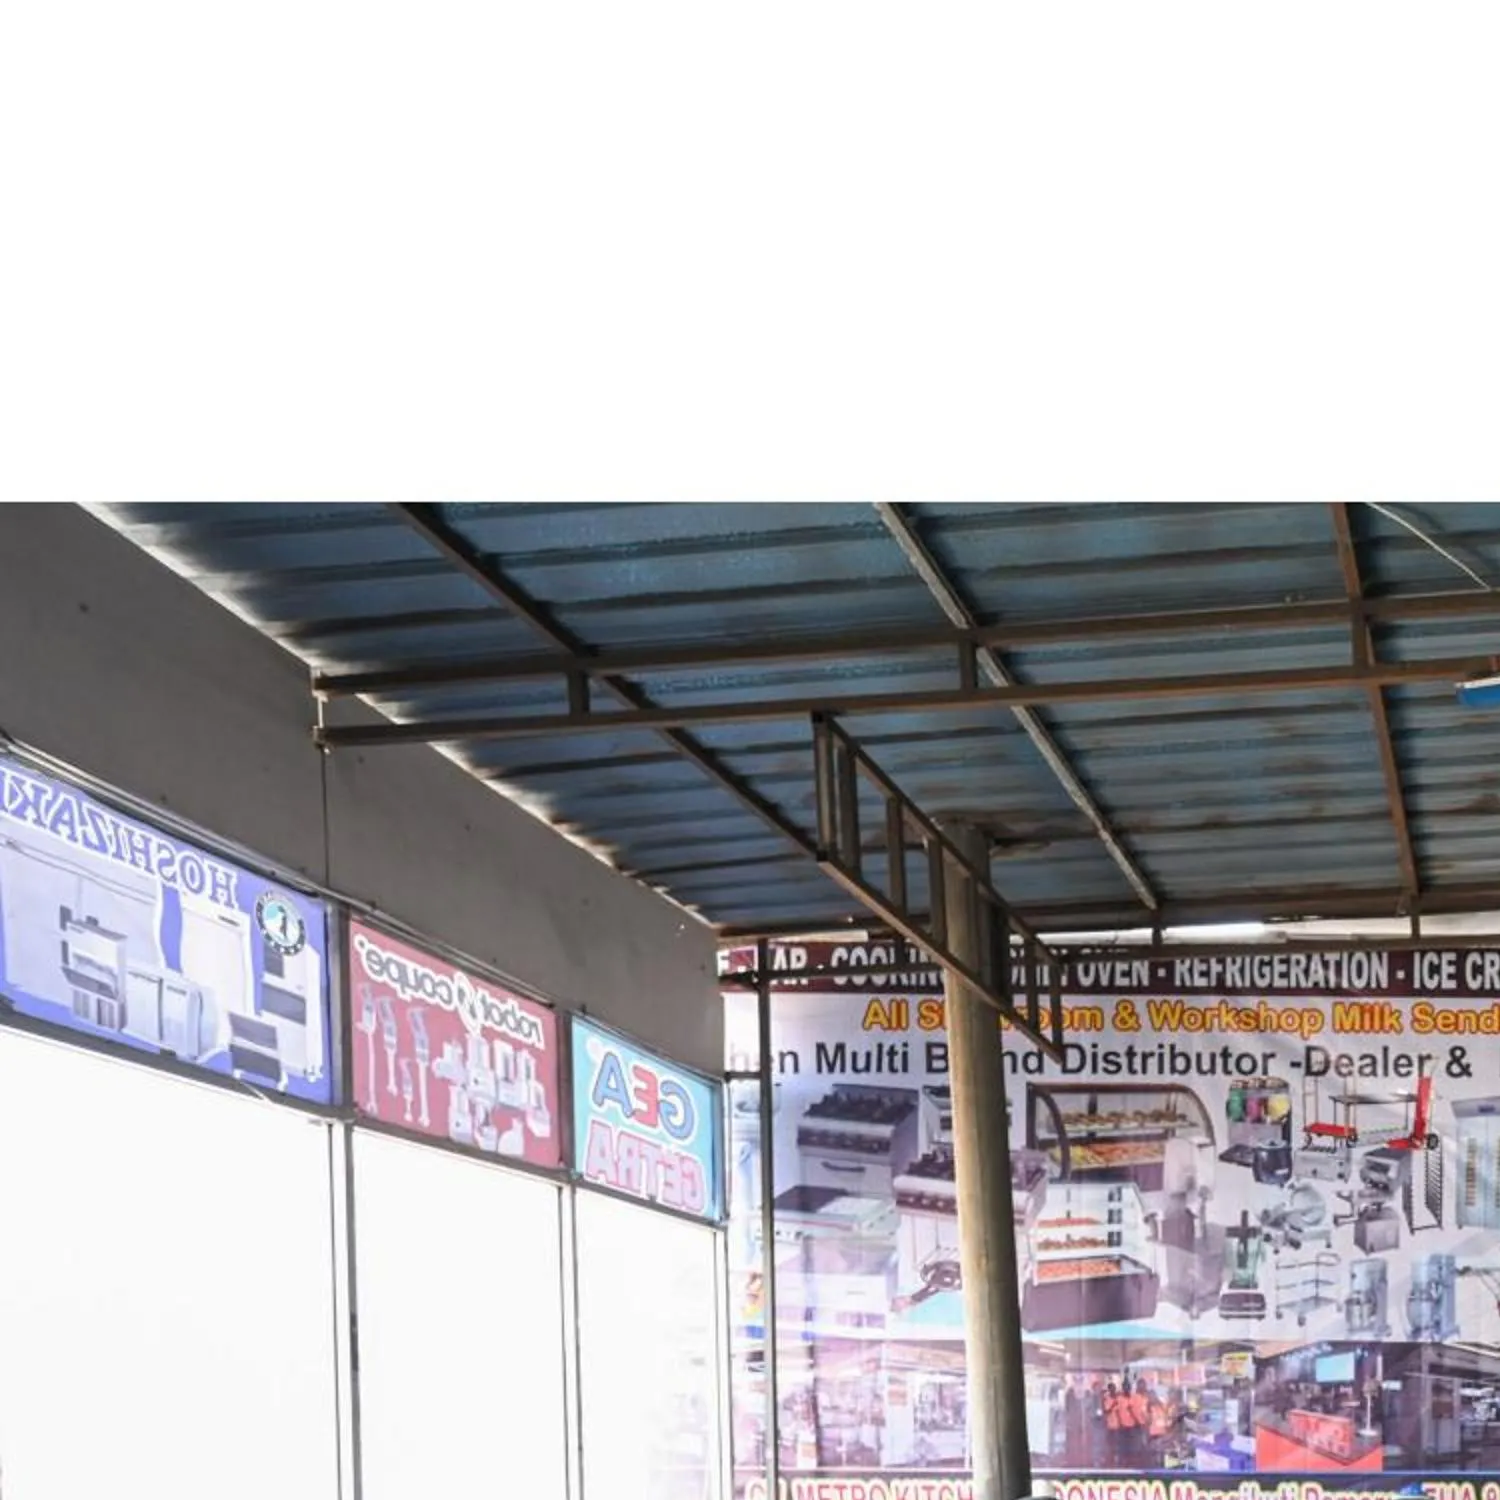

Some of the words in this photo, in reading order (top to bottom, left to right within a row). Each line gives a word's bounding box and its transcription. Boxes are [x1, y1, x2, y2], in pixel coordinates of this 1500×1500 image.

[1174, 953, 1388, 988] REFRIGERATION
[1413, 953, 1456, 990] ICE
[863, 1000, 908, 1031] All
[1112, 999, 1142, 1032] &
[1147, 1000, 1324, 1039] Workshop
[1334, 1002, 1402, 1034] Milk
[815, 1041, 909, 1073] Multi
[1062, 1041, 1274, 1075] Distributor
[1446, 1048, 1472, 1078] &
